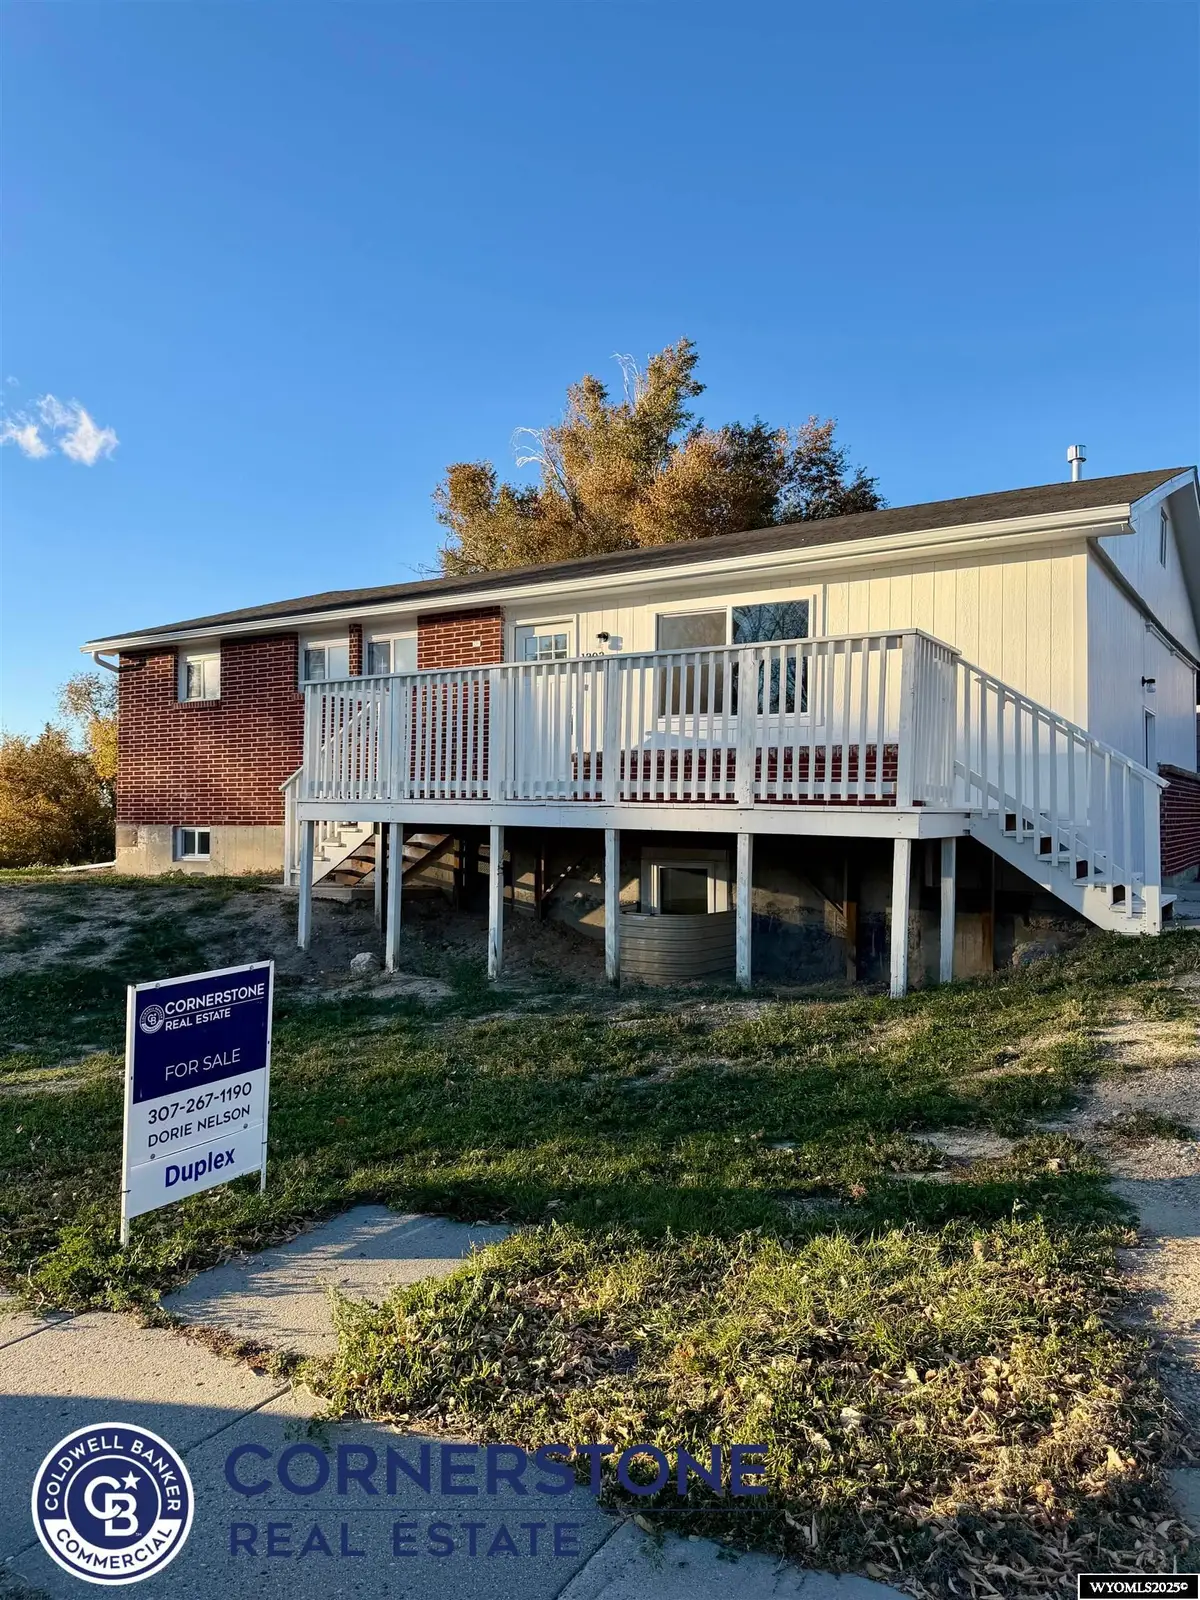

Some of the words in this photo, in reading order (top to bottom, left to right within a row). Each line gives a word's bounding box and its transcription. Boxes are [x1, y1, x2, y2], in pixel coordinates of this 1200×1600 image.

[165, 983, 265, 1015] CORNERSTONE
[165, 1016, 193, 1031] REAL
[196, 1007, 231, 1024] ESTATE
[165, 1059, 198, 1081] FOR
[203, 1048, 241, 1071] SALE
[148, 1082, 252, 1125] 307-267-1190
[148, 1122, 193, 1148] DORIE
[197, 1104, 250, 1132] NELSON
[165, 1148, 236, 1188] Duplex
